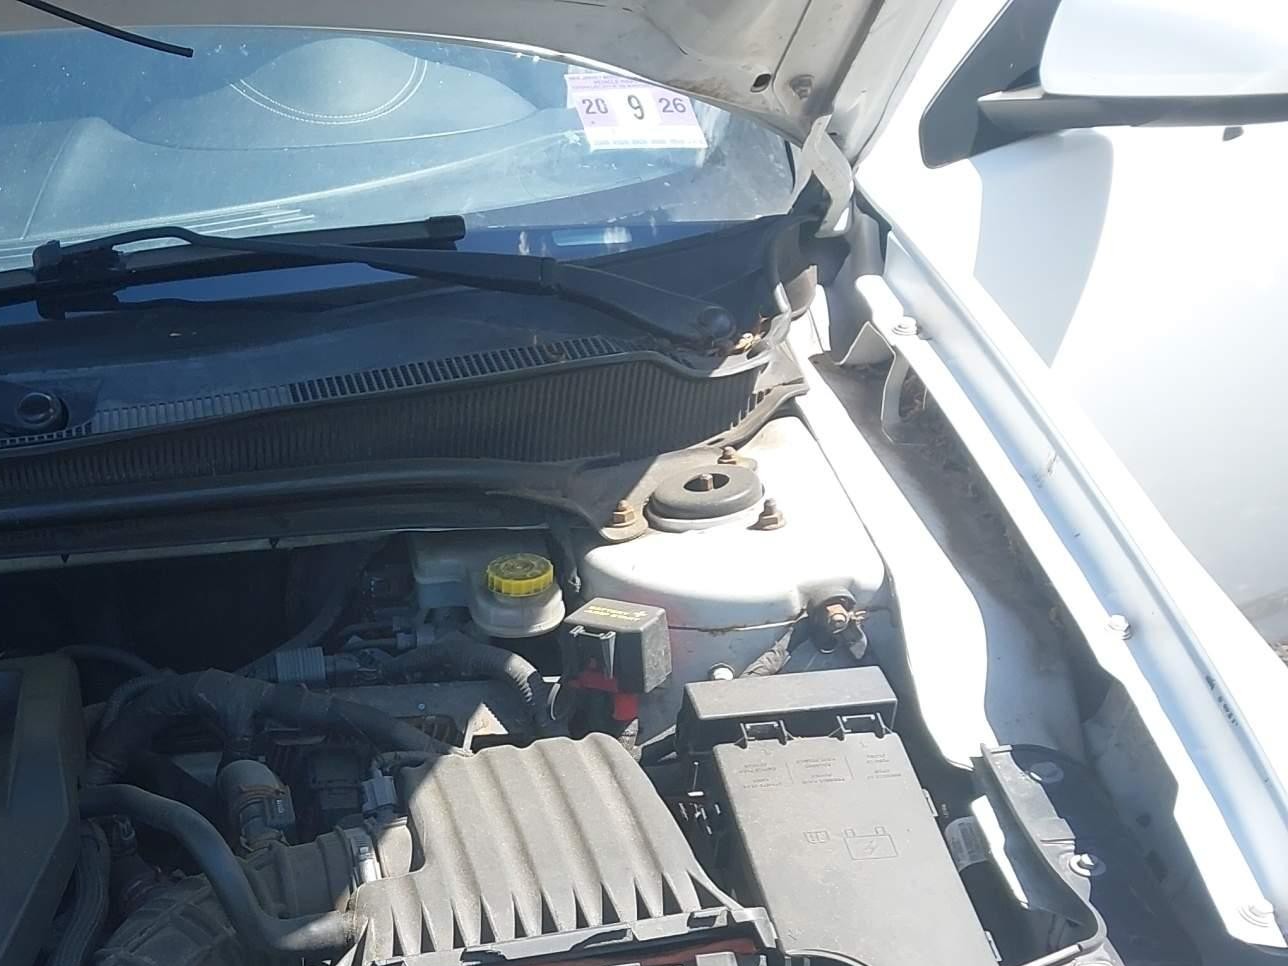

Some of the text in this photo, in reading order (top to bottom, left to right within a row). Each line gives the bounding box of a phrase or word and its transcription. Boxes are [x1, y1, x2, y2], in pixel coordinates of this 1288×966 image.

[582, 93, 686, 120] 20 9 26
